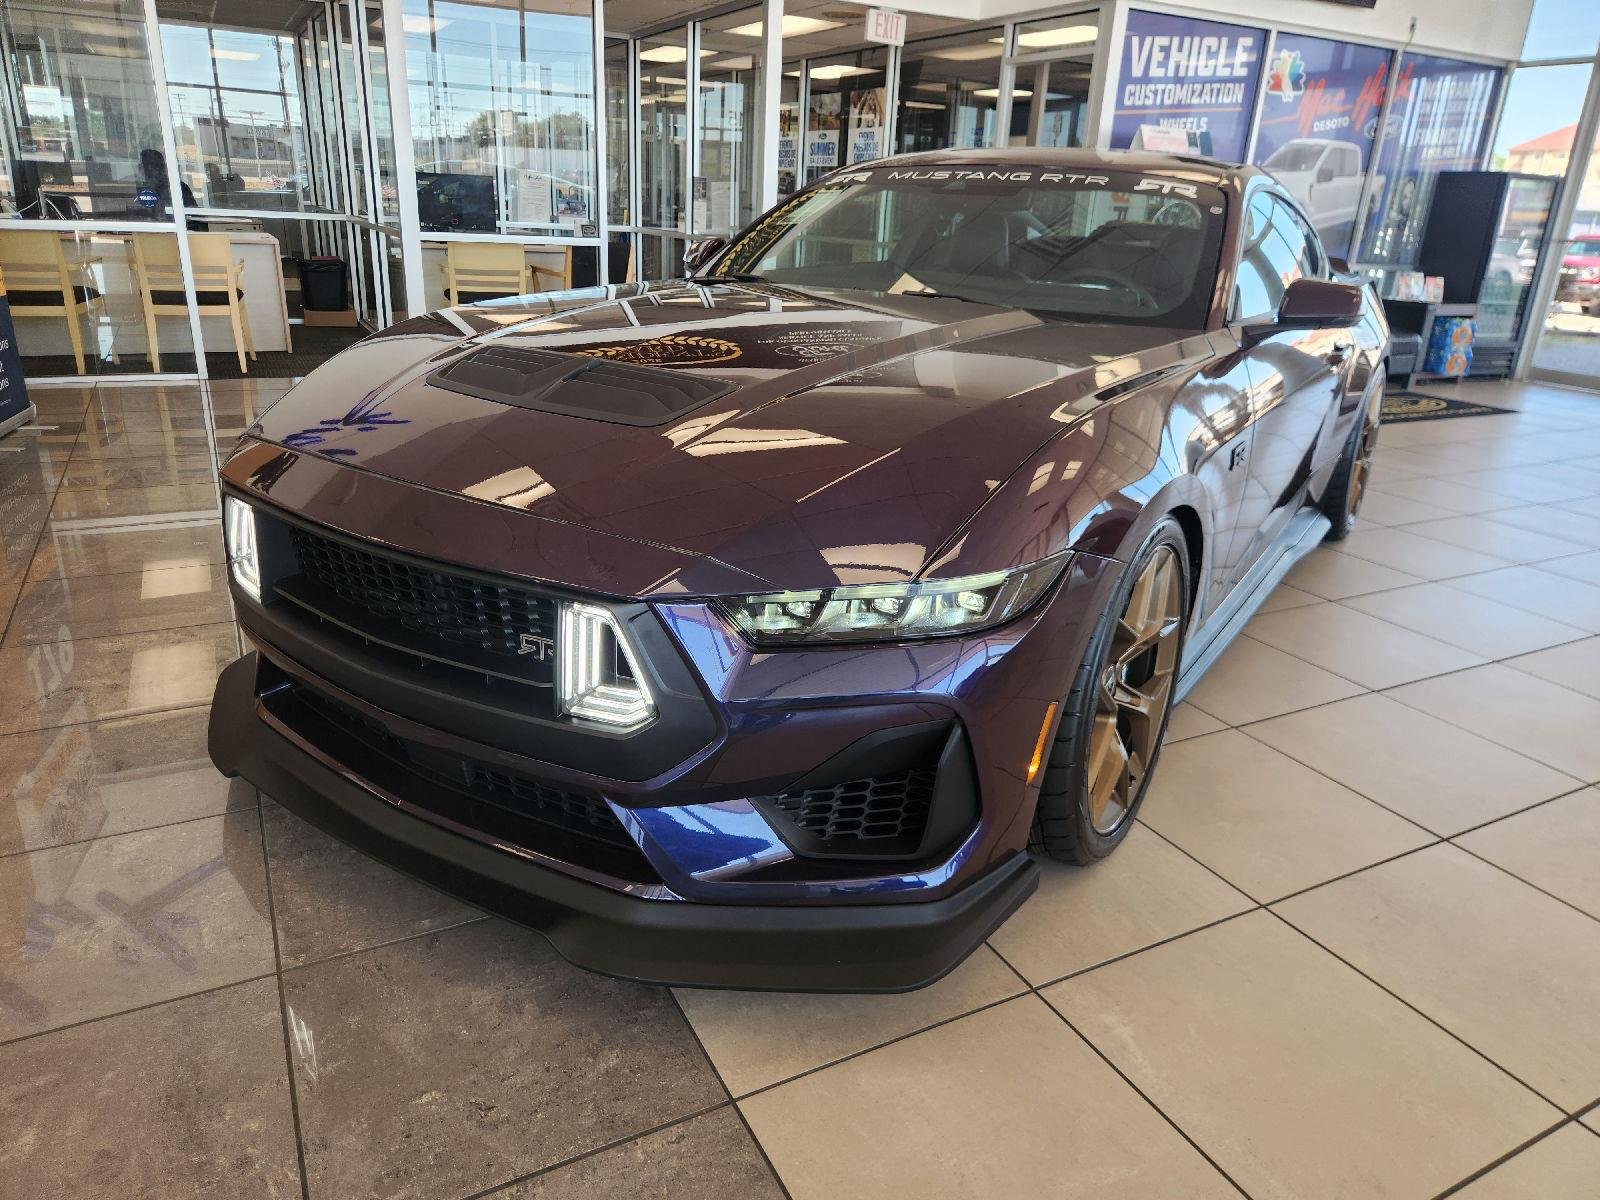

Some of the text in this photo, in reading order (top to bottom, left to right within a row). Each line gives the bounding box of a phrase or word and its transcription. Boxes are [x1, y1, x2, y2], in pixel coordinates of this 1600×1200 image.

[874, 12, 902, 40] EXIT
[1131, 35, 1254, 78] VEHICLE
[1123, 82, 1246, 106] CUSTOMIZATION
[1159, 116, 1209, 132] WHEELS
[1313, 115, 1350, 132] DESOTO
[809, 141, 836, 157] SUMMER
[887, 170, 1111, 187] MUSTANG RTR
